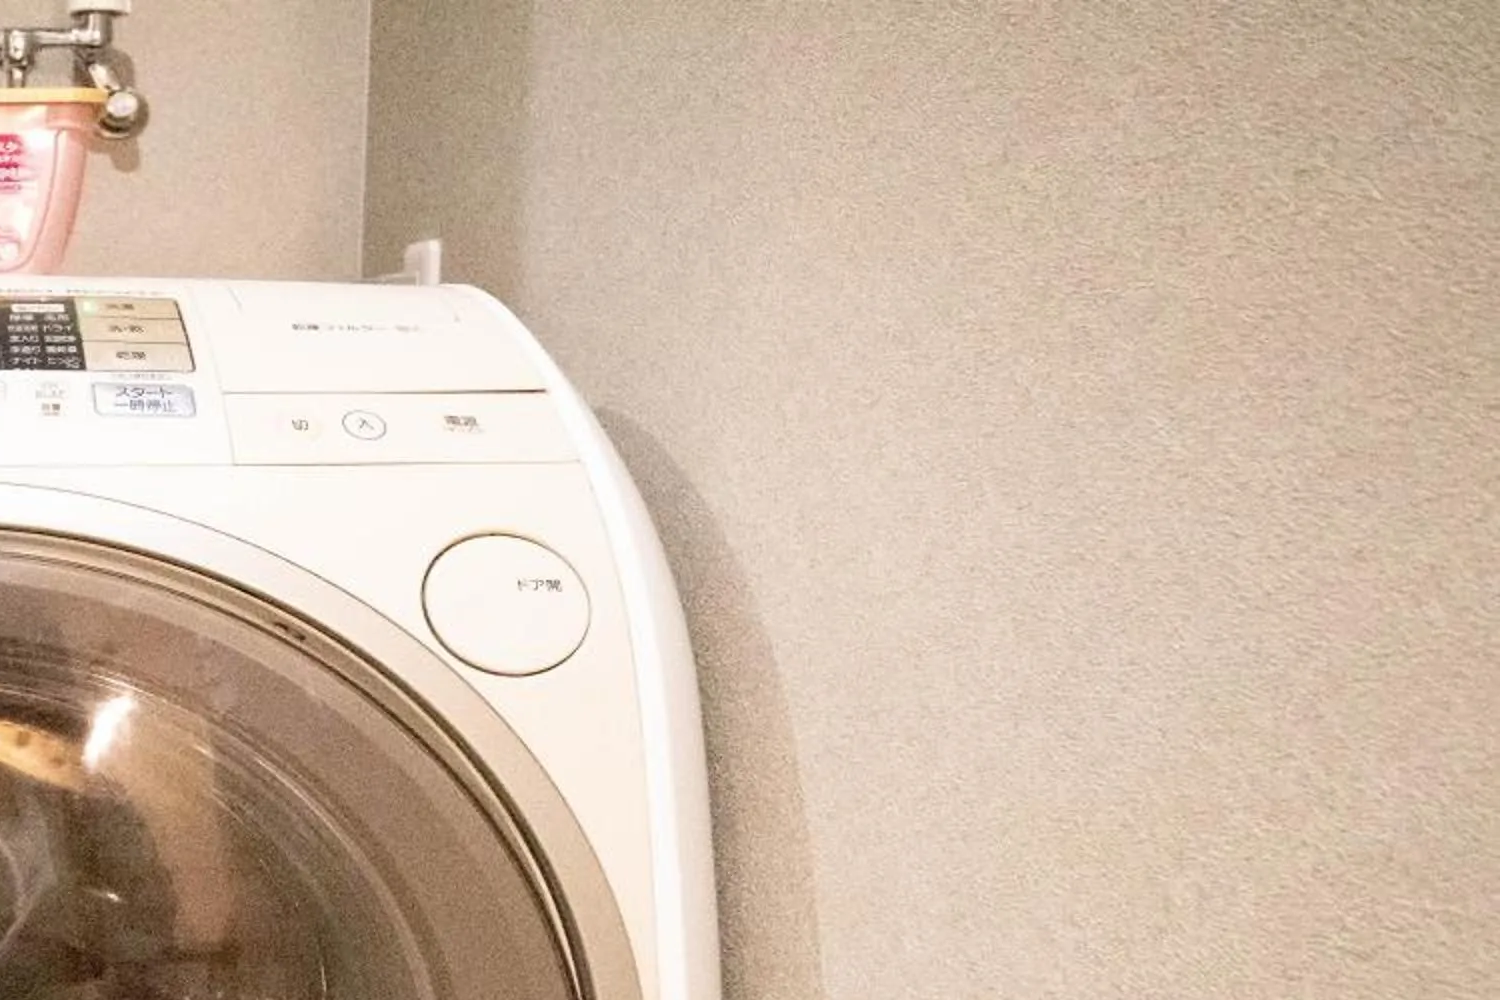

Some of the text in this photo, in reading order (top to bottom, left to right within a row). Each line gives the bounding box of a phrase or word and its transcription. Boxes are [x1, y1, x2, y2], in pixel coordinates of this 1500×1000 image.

[115, 385, 173, 399] スタート
[114, 399, 178, 412] 一時停止
